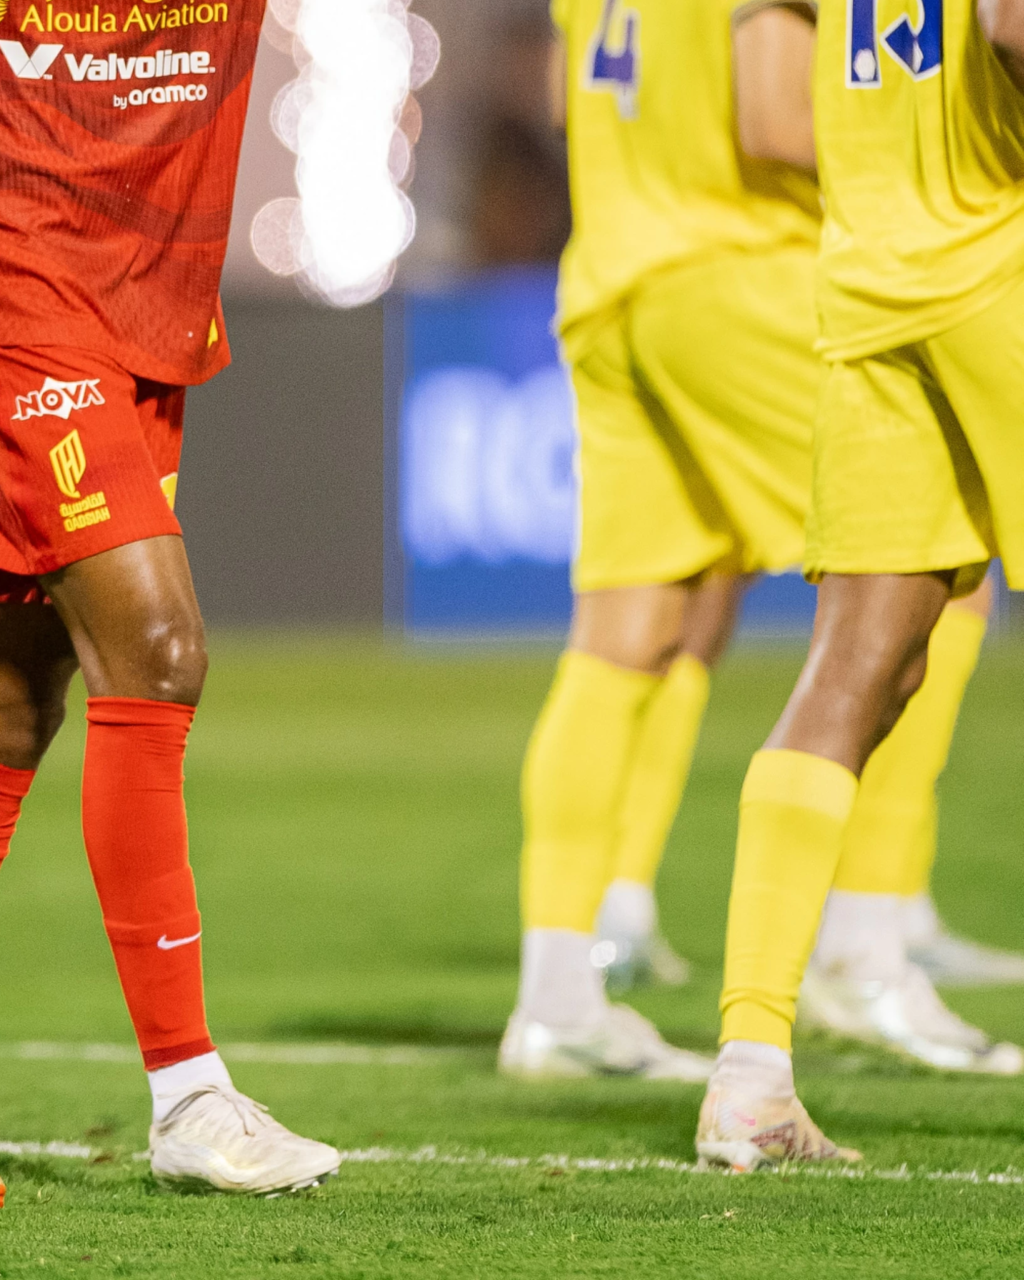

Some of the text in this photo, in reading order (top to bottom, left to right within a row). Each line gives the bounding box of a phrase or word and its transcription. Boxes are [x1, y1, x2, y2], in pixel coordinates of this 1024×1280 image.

[20, 4, 117, 33] Aloula
[64, 49, 211, 82] Valvoline
[113, 84, 208, 110] by aramco
[11, 376, 106, 420] NOVA
[63, 506, 111, 532] QADSIAH
